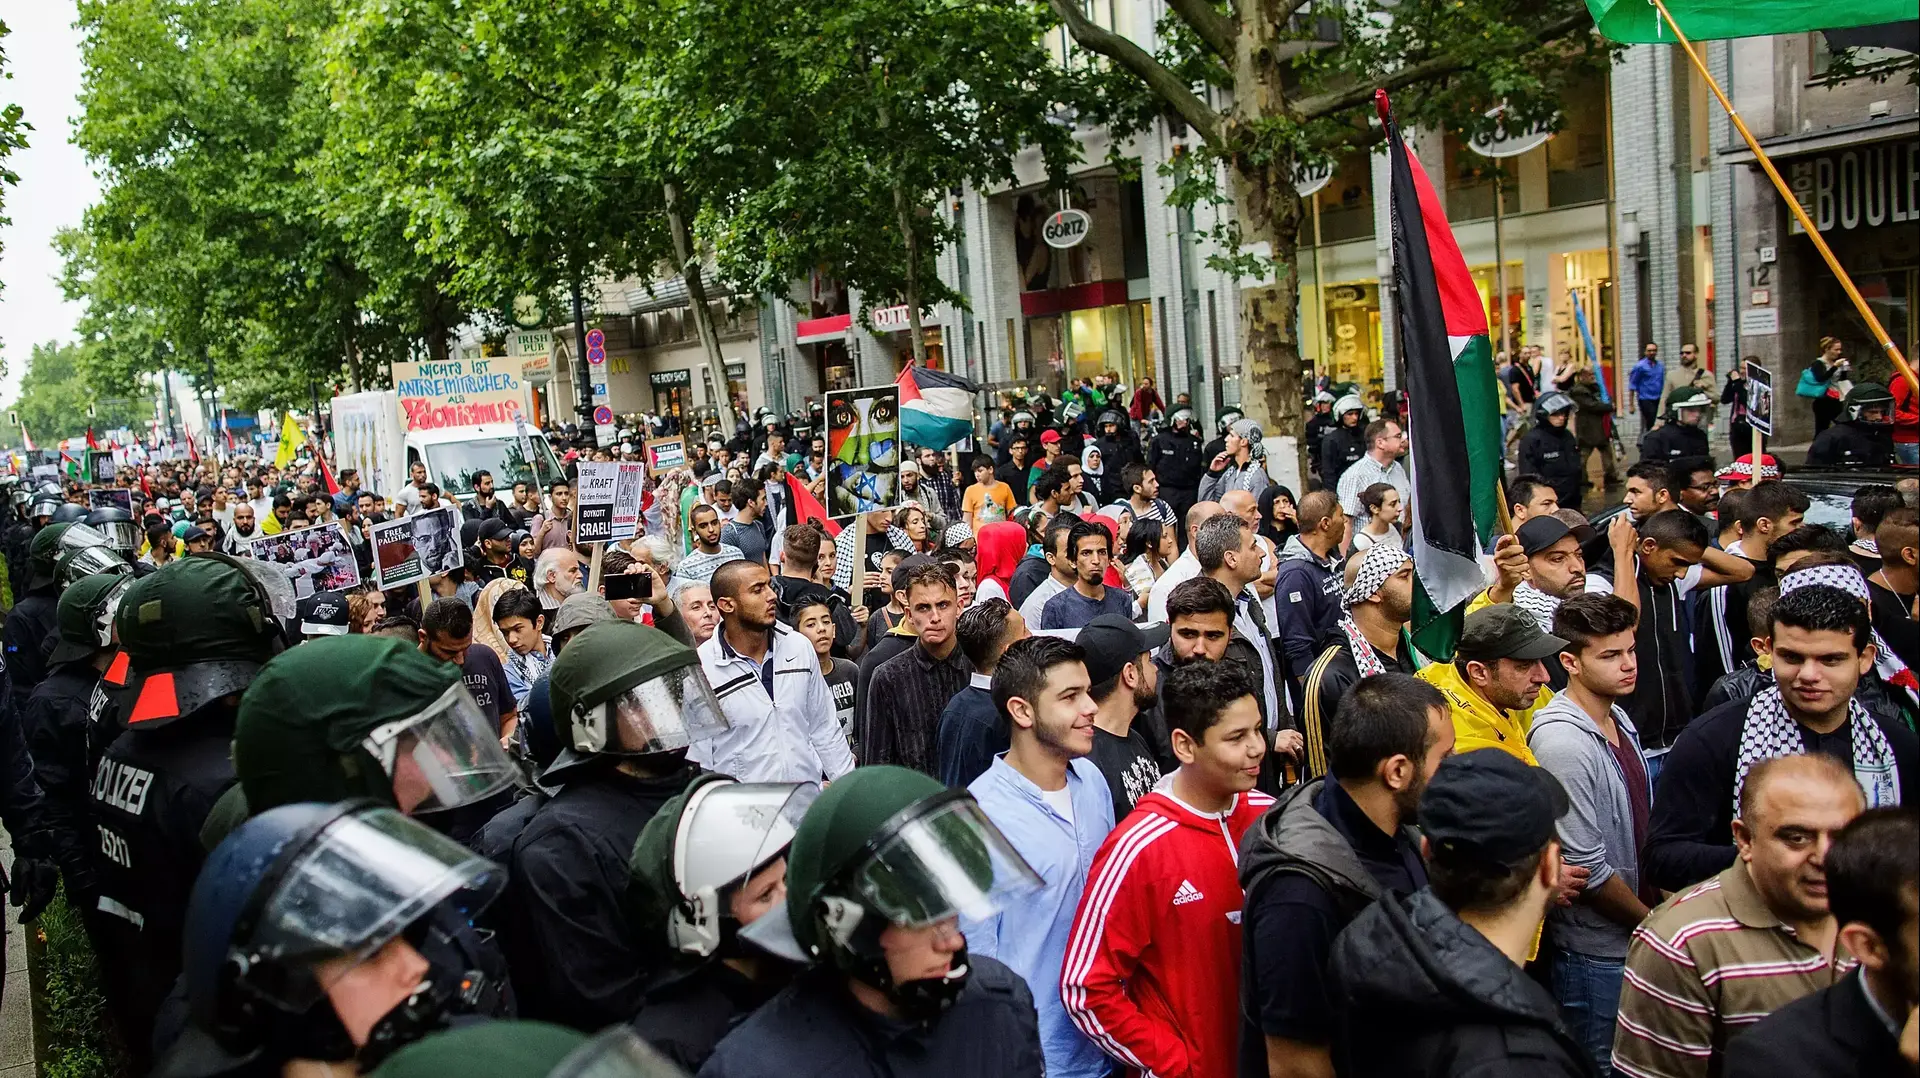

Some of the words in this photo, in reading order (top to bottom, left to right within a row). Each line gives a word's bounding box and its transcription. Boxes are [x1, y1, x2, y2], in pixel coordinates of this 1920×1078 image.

[1746, 266, 1770, 287] 12
[518, 334, 548, 344] IRISH
[523, 343, 545, 352] PUB
[651, 374, 660, 383] THE
[661, 372, 674, 383] BODY
[675, 370, 688, 382] SHOP
[656, 444, 678, 452] ISRAEL
[581, 468, 597, 476] DEINE
[589, 478, 614, 489] KRAFT
[583, 509, 606, 518] BOYKOTT
[476, 692, 492, 707] 62
[1173, 892, 1204, 905] adidas
